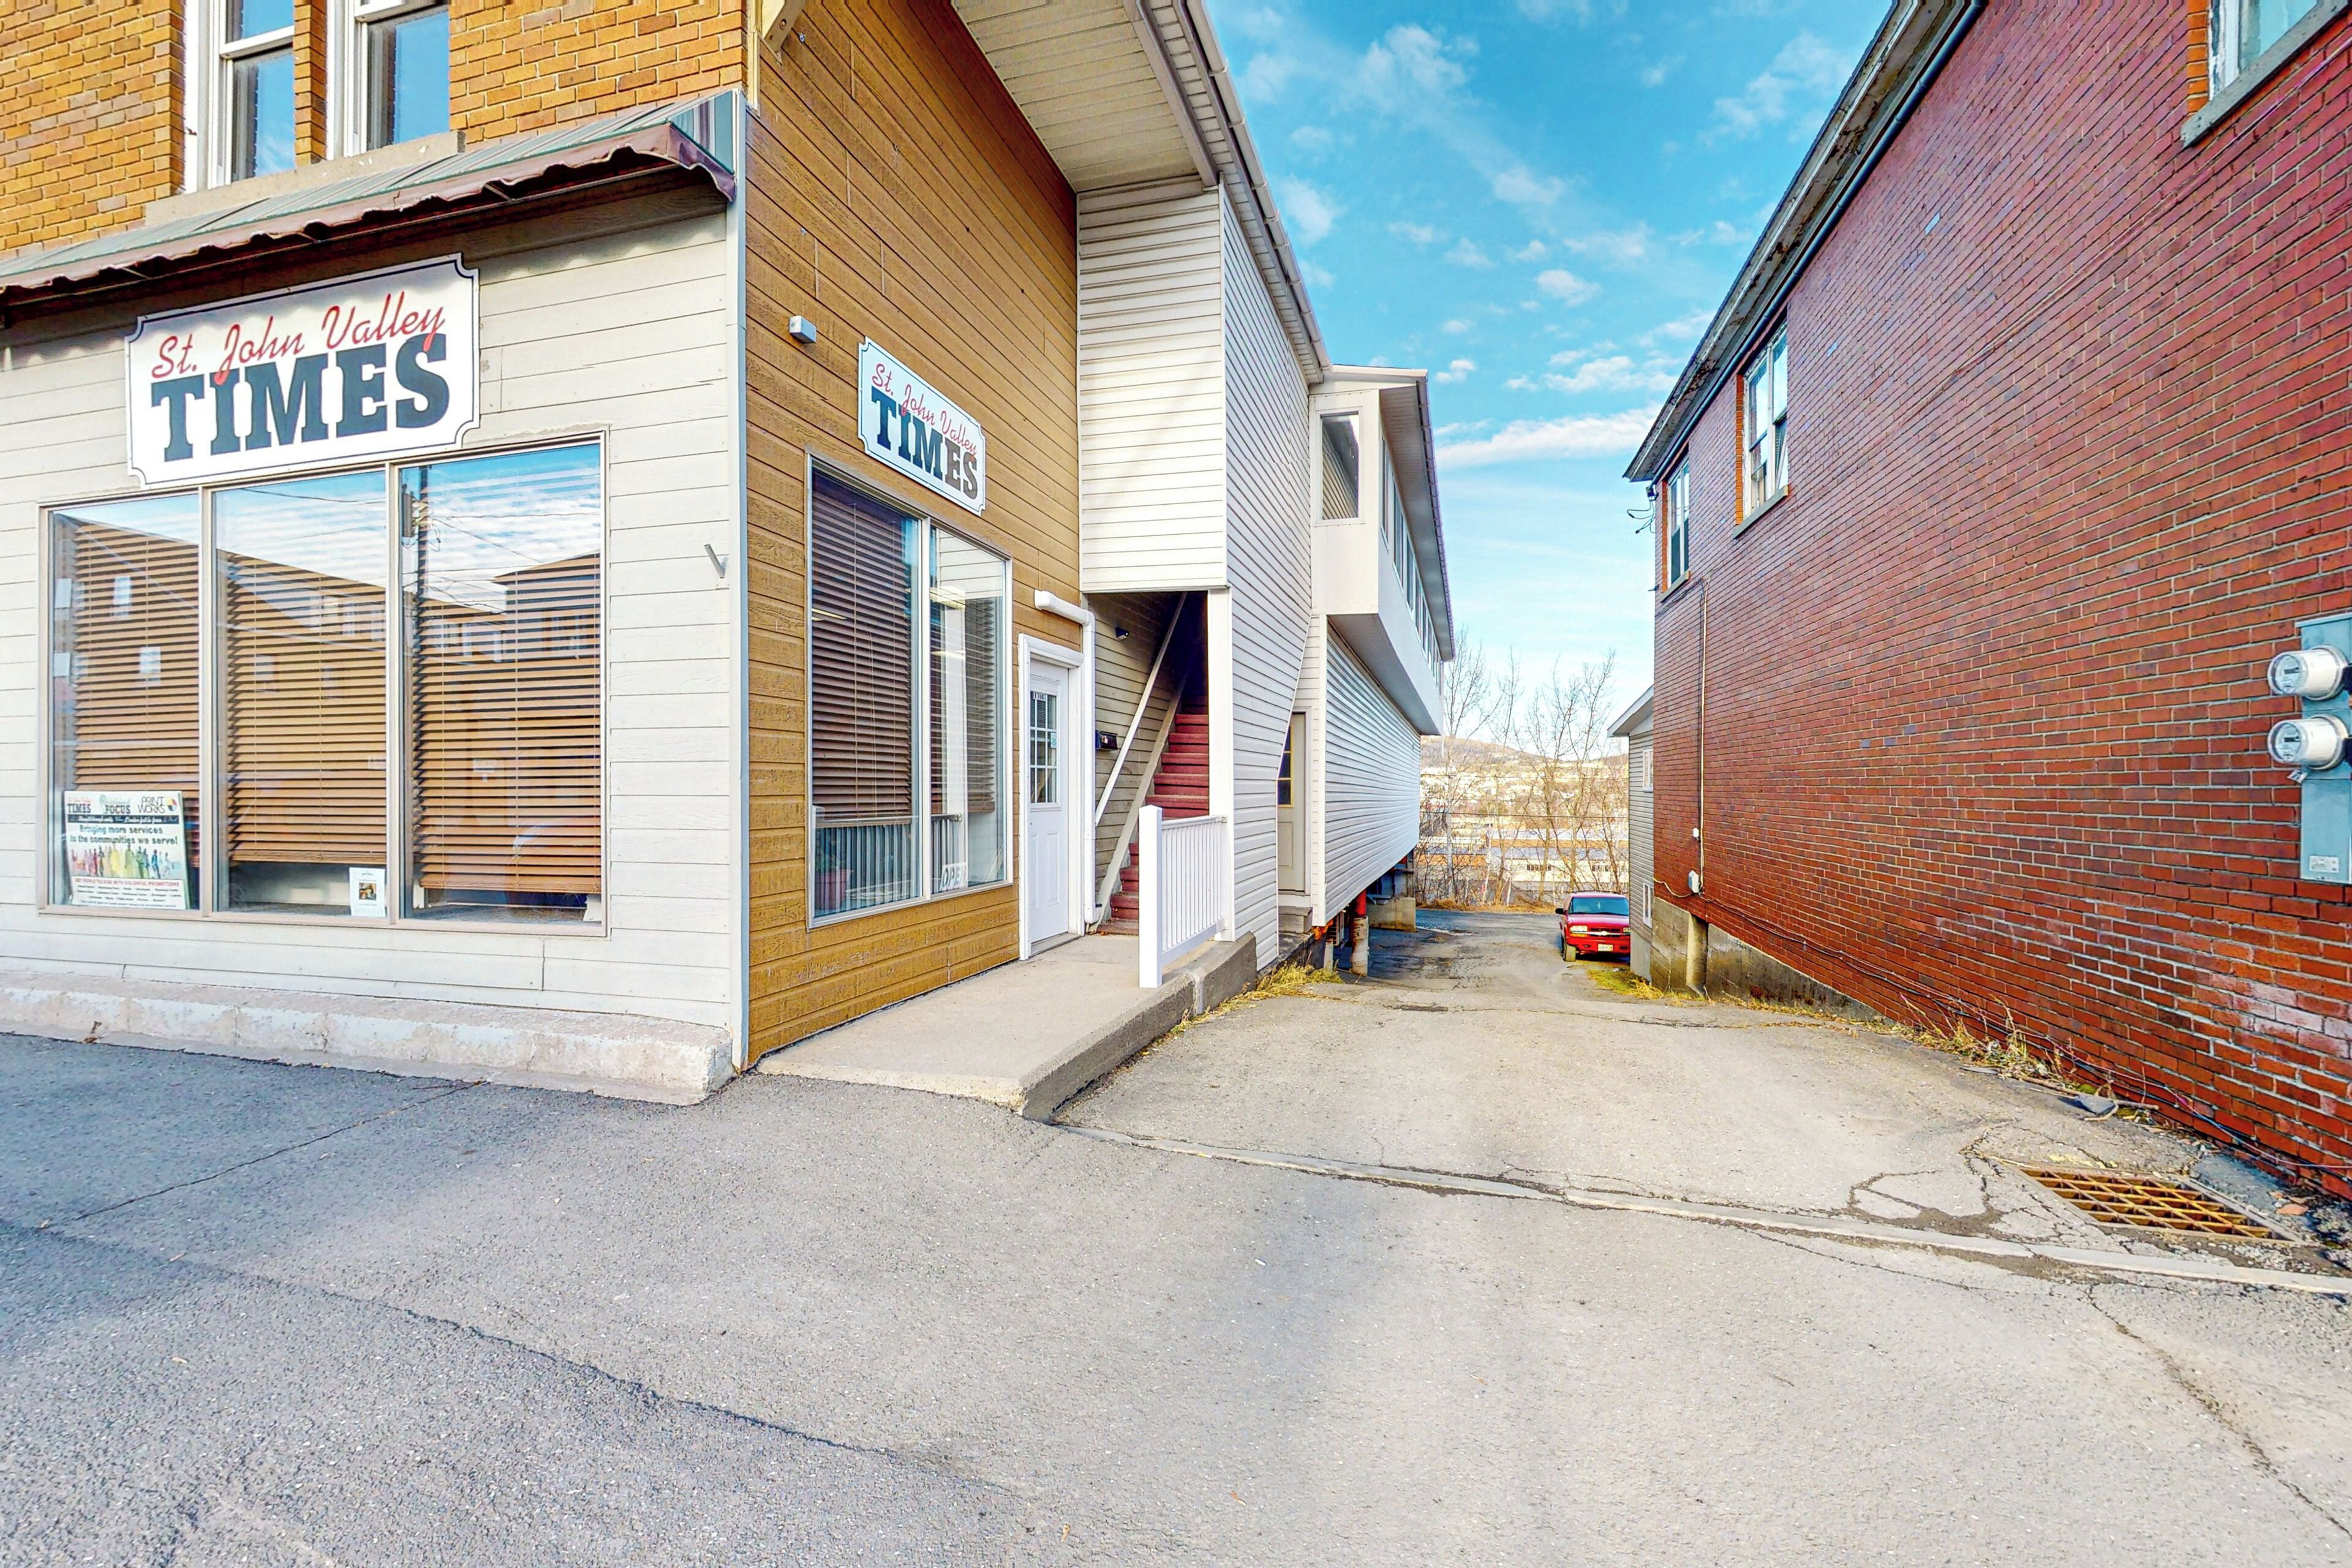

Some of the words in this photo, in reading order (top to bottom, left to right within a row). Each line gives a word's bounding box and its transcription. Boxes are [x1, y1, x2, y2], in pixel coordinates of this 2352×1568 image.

[152, 335, 197, 379] St.
[214, 315, 304, 385] John
[322, 290, 445, 352] Valley
[151, 333, 450, 462] TIMES
[872, 363, 894, 396] St.
[900, 384, 935, 426] John
[940, 410, 978, 461] Valley
[871, 385, 978, 500] TIMES
[141, 796, 164, 806] PRINT
[67, 803, 91, 813] TIMES
[105, 805, 131, 814] FOCUS
[137, 805, 165, 814] WORKS
[80, 824, 107, 834] Bringing
[90, 835, 136, 844] communities
[152, 836, 178, 845] serve!
[942, 865, 967, 888] OPEN
